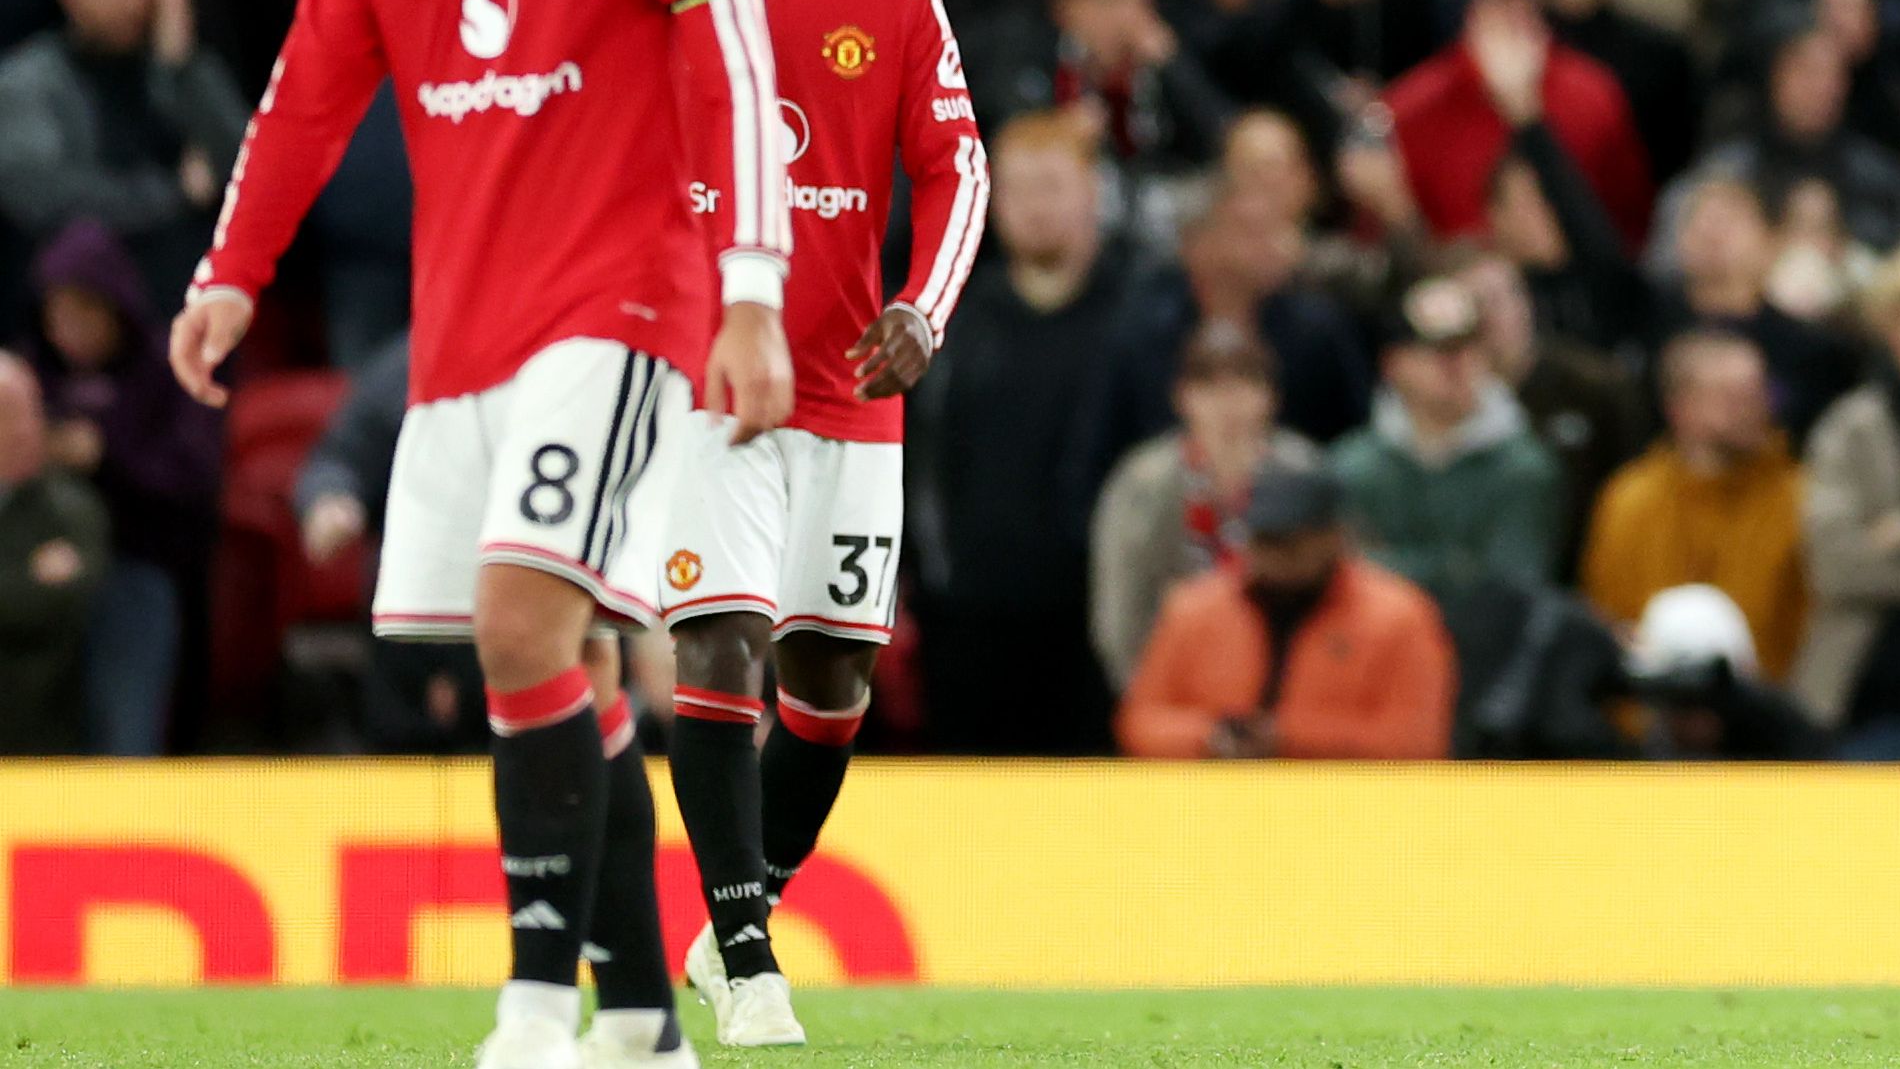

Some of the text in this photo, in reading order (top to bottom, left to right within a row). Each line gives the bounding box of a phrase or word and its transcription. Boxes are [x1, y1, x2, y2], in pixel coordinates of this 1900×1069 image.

[519, 443, 580, 525] 8
[827, 534, 894, 607] 37
[712, 881, 763, 903] MUFC
